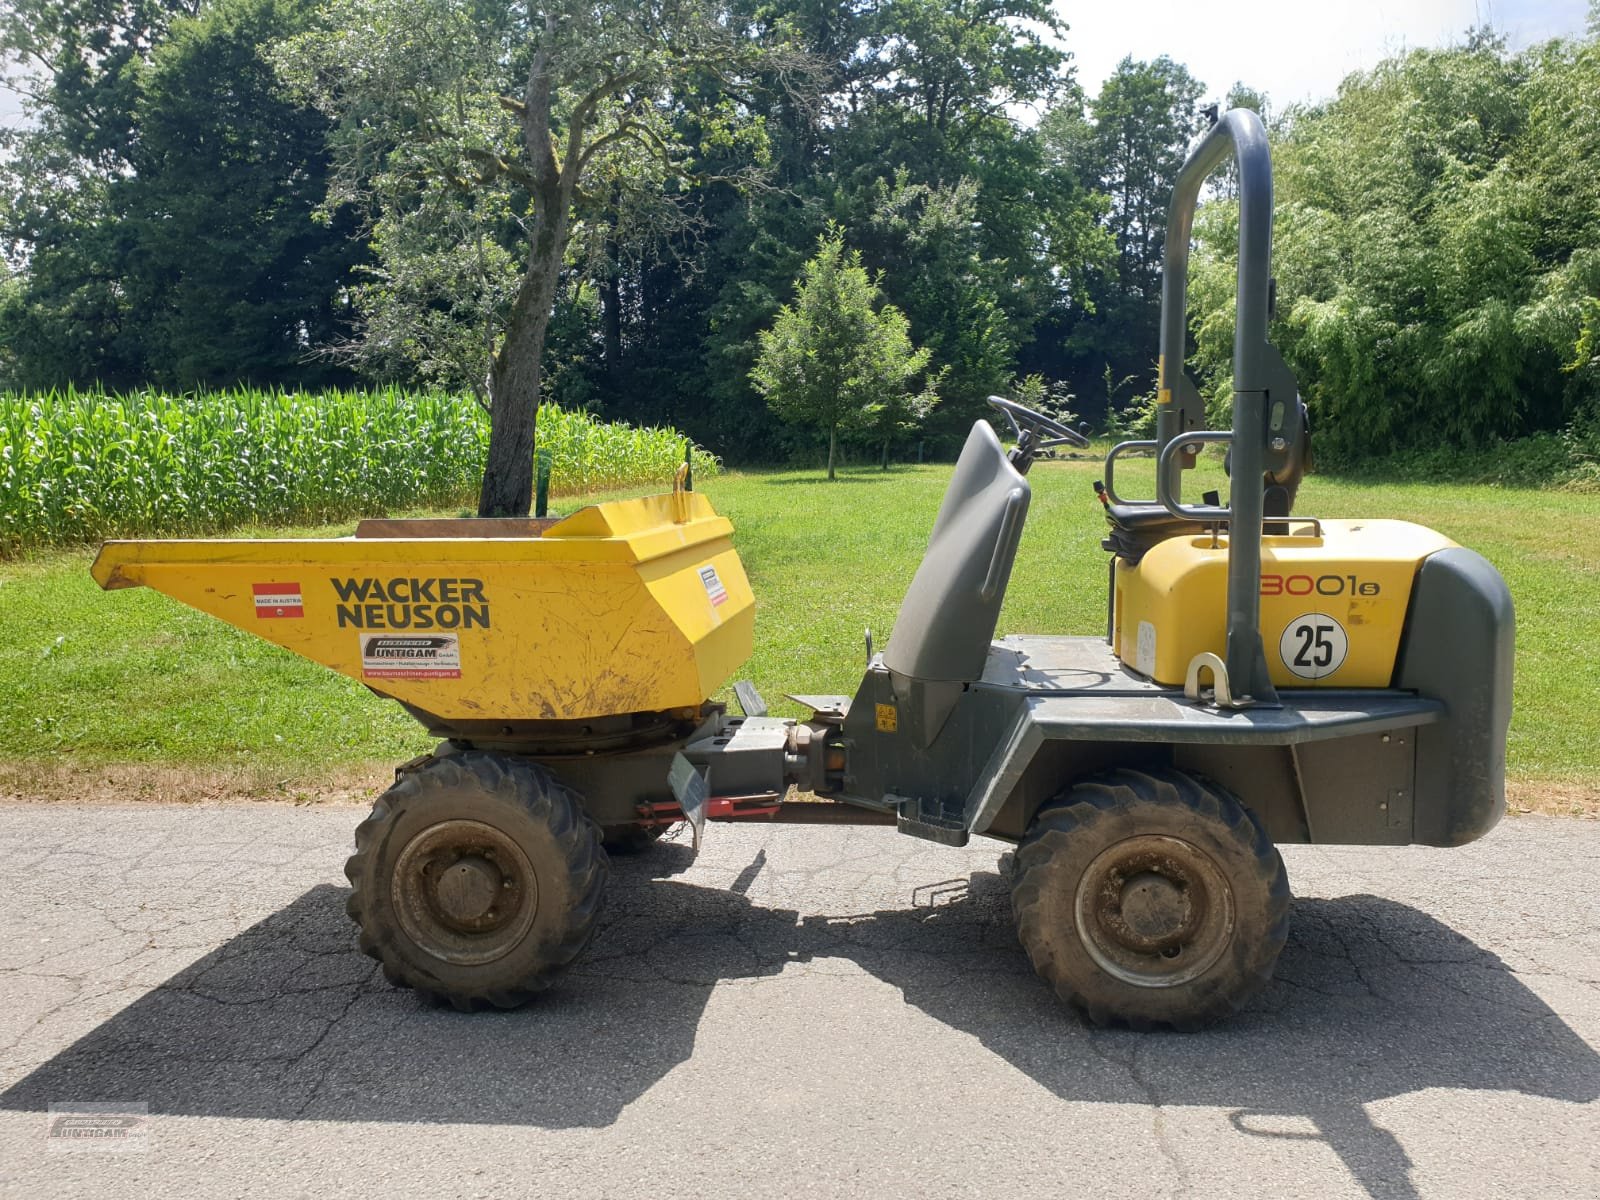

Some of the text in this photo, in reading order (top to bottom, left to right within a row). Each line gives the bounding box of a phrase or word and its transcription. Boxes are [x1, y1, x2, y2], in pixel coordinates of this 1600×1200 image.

[330, 577, 490, 603] WACKER
[336, 604, 491, 629] NEUSON
[1293, 625, 1335, 667] 25
